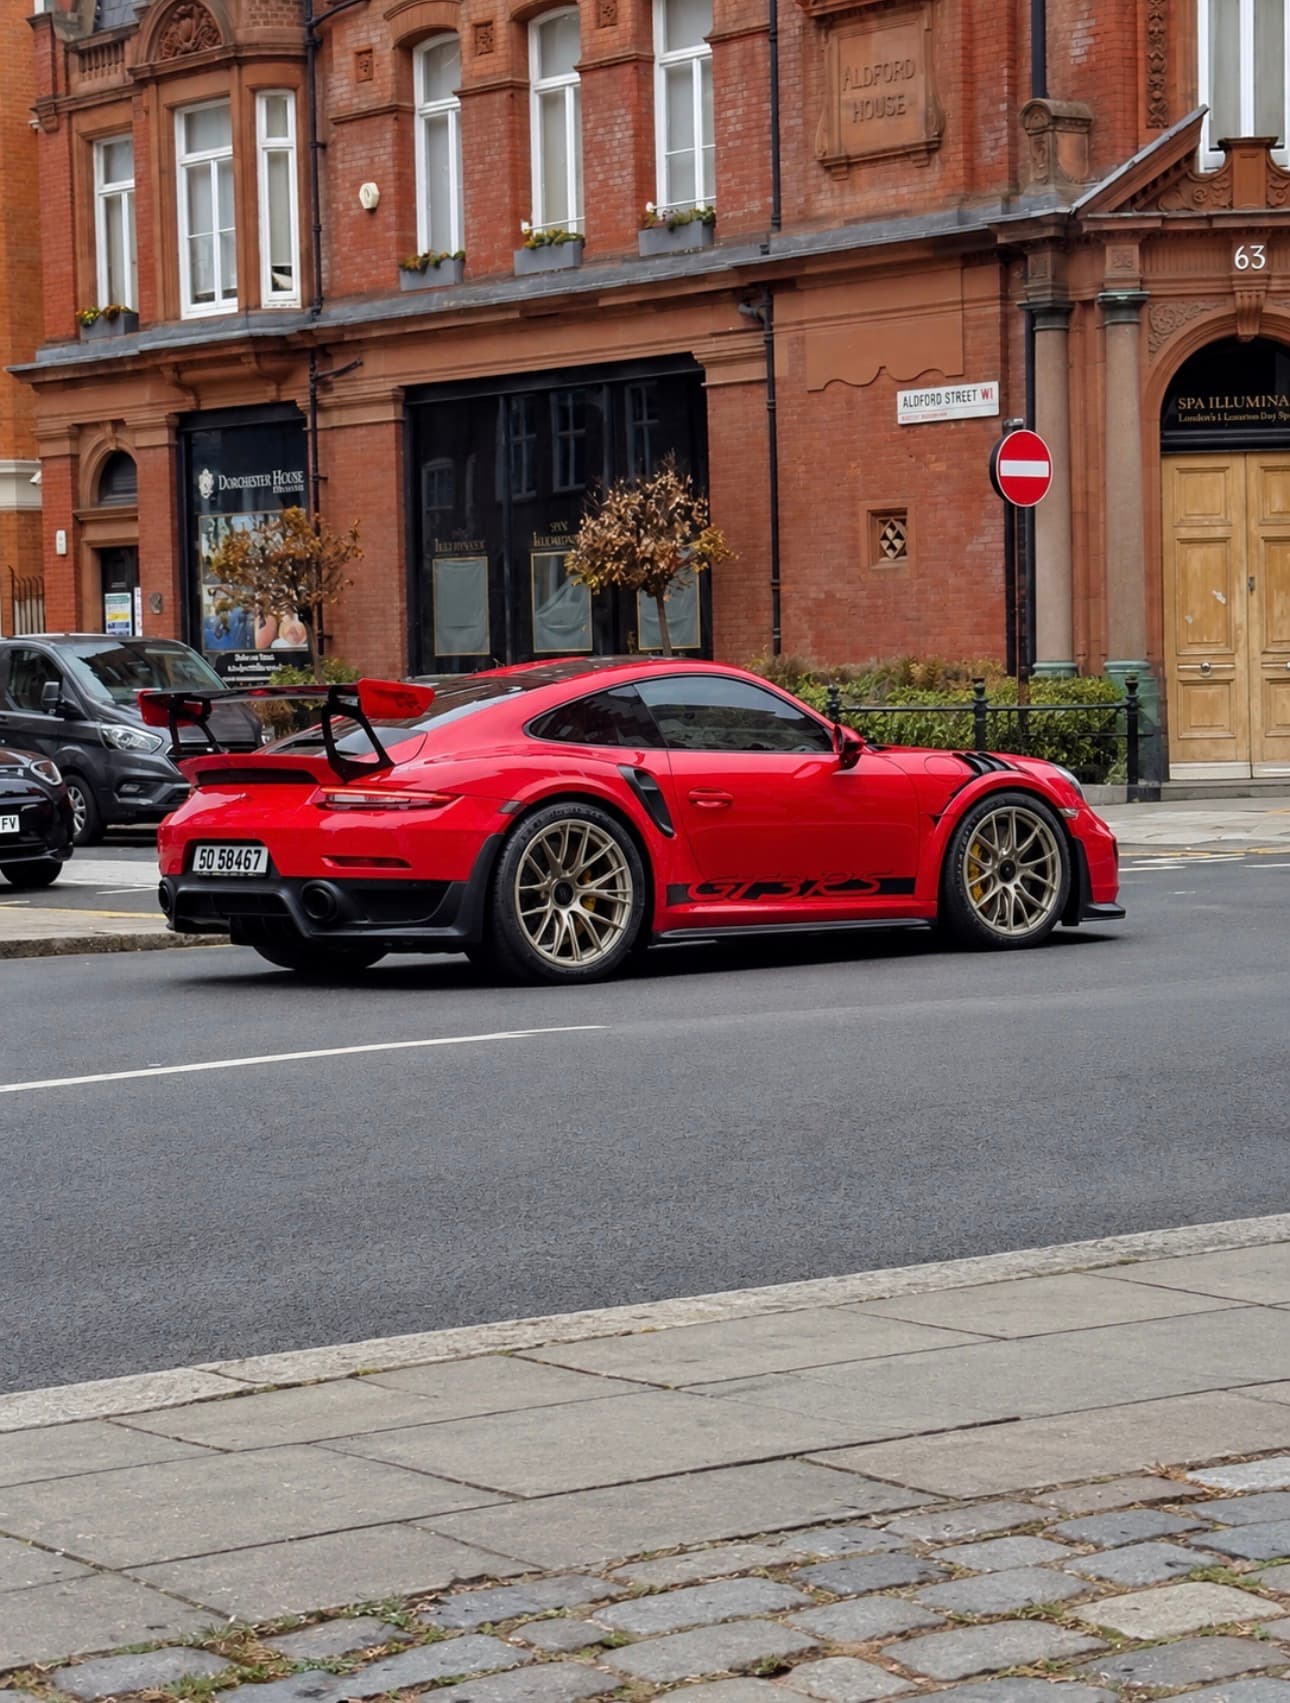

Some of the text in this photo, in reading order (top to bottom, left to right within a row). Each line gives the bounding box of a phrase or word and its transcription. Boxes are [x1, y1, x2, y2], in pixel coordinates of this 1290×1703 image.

[842, 58, 916, 92] ALDFORD
[852, 95, 906, 123] HOUSE
[1234, 244, 1266, 270] 63
[903, 387, 993, 408] ALDFORD STREET W1
[1178, 397, 1205, 409] SPA
[272, 470, 304, 486] HOUSE
[199, 848, 262, 870] 50 58467
